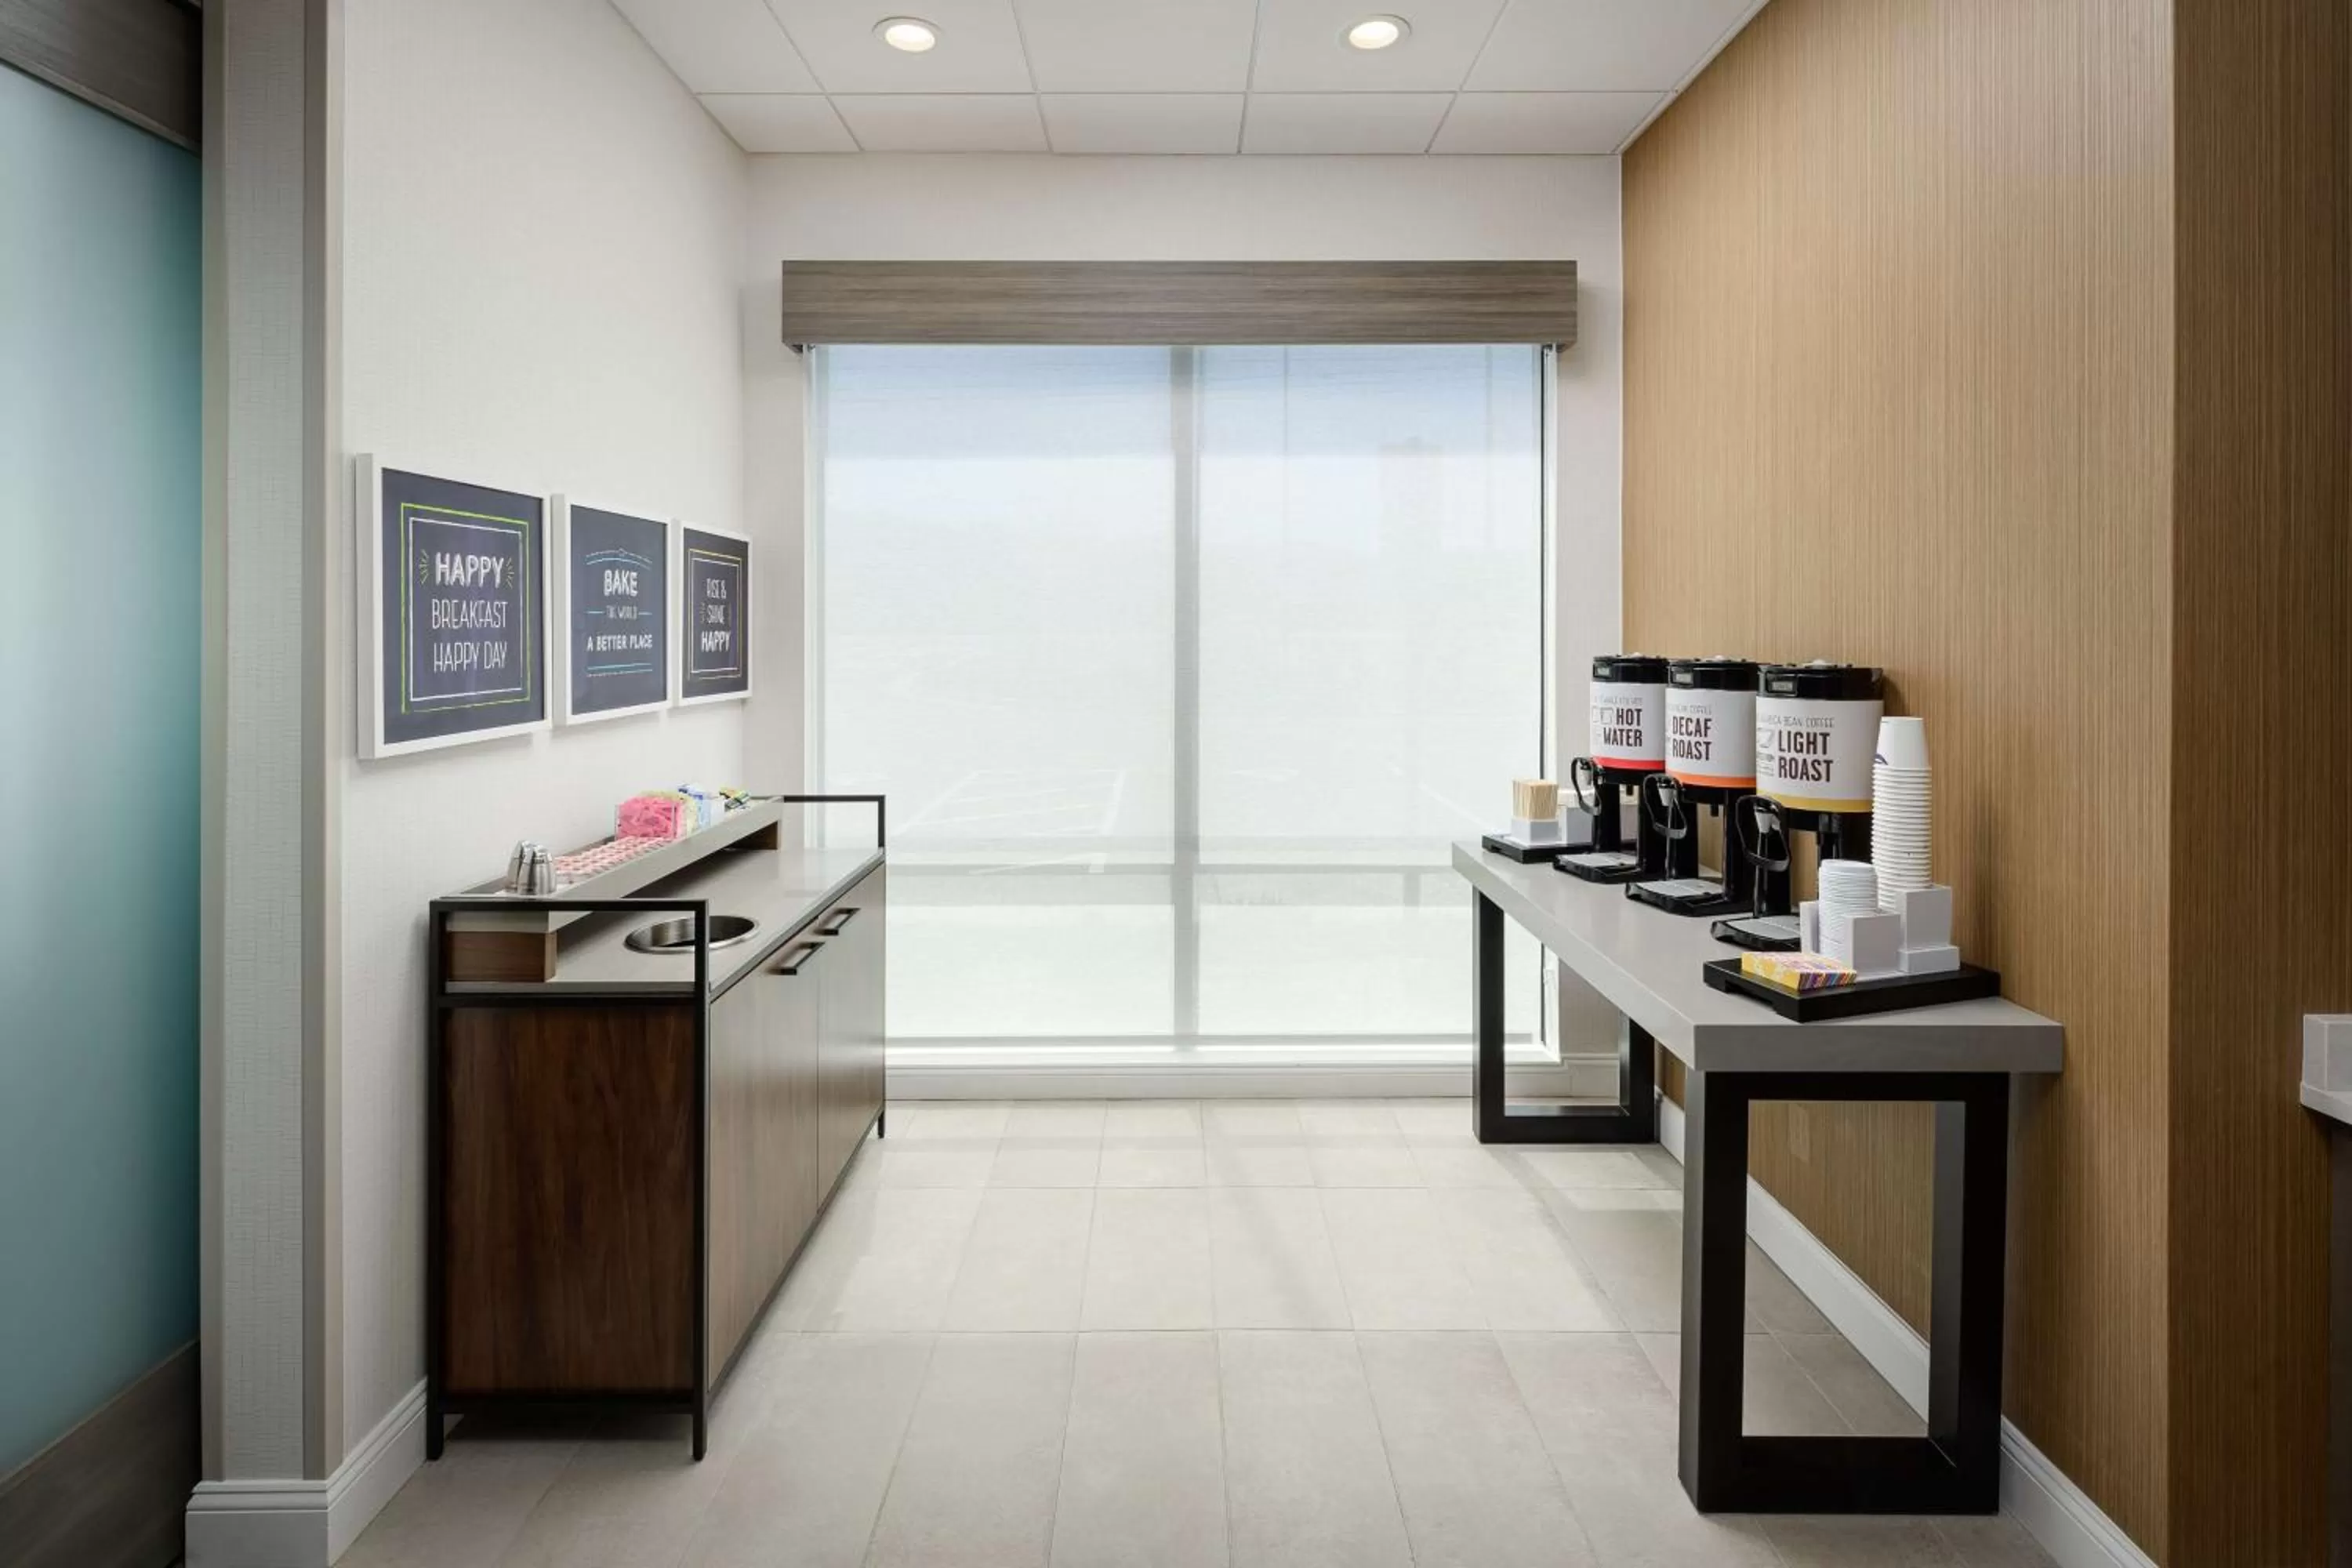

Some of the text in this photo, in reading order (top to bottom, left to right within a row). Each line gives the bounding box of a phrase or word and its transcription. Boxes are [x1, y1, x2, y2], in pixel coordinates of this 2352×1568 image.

[435, 552, 504, 588] HAPPY
[604, 568, 638, 597] BAKE
[432, 598, 508, 629] BREAKFAST
[586, 633, 653, 652] A BETTER PLACE
[701, 630, 731, 652] HAPPY
[434, 641, 507, 673] HAPPY DAY
[1616, 707, 1642, 727] HOT
[1672, 716, 1712, 738] DECAF
[1806, 717, 1835, 729] COFFEE
[1603, 727, 1642, 747] WATER
[1778, 729, 1831, 756] LIGHT
[1672, 739, 1712, 761] ROAST
[1778, 756, 1834, 783] ROAST
